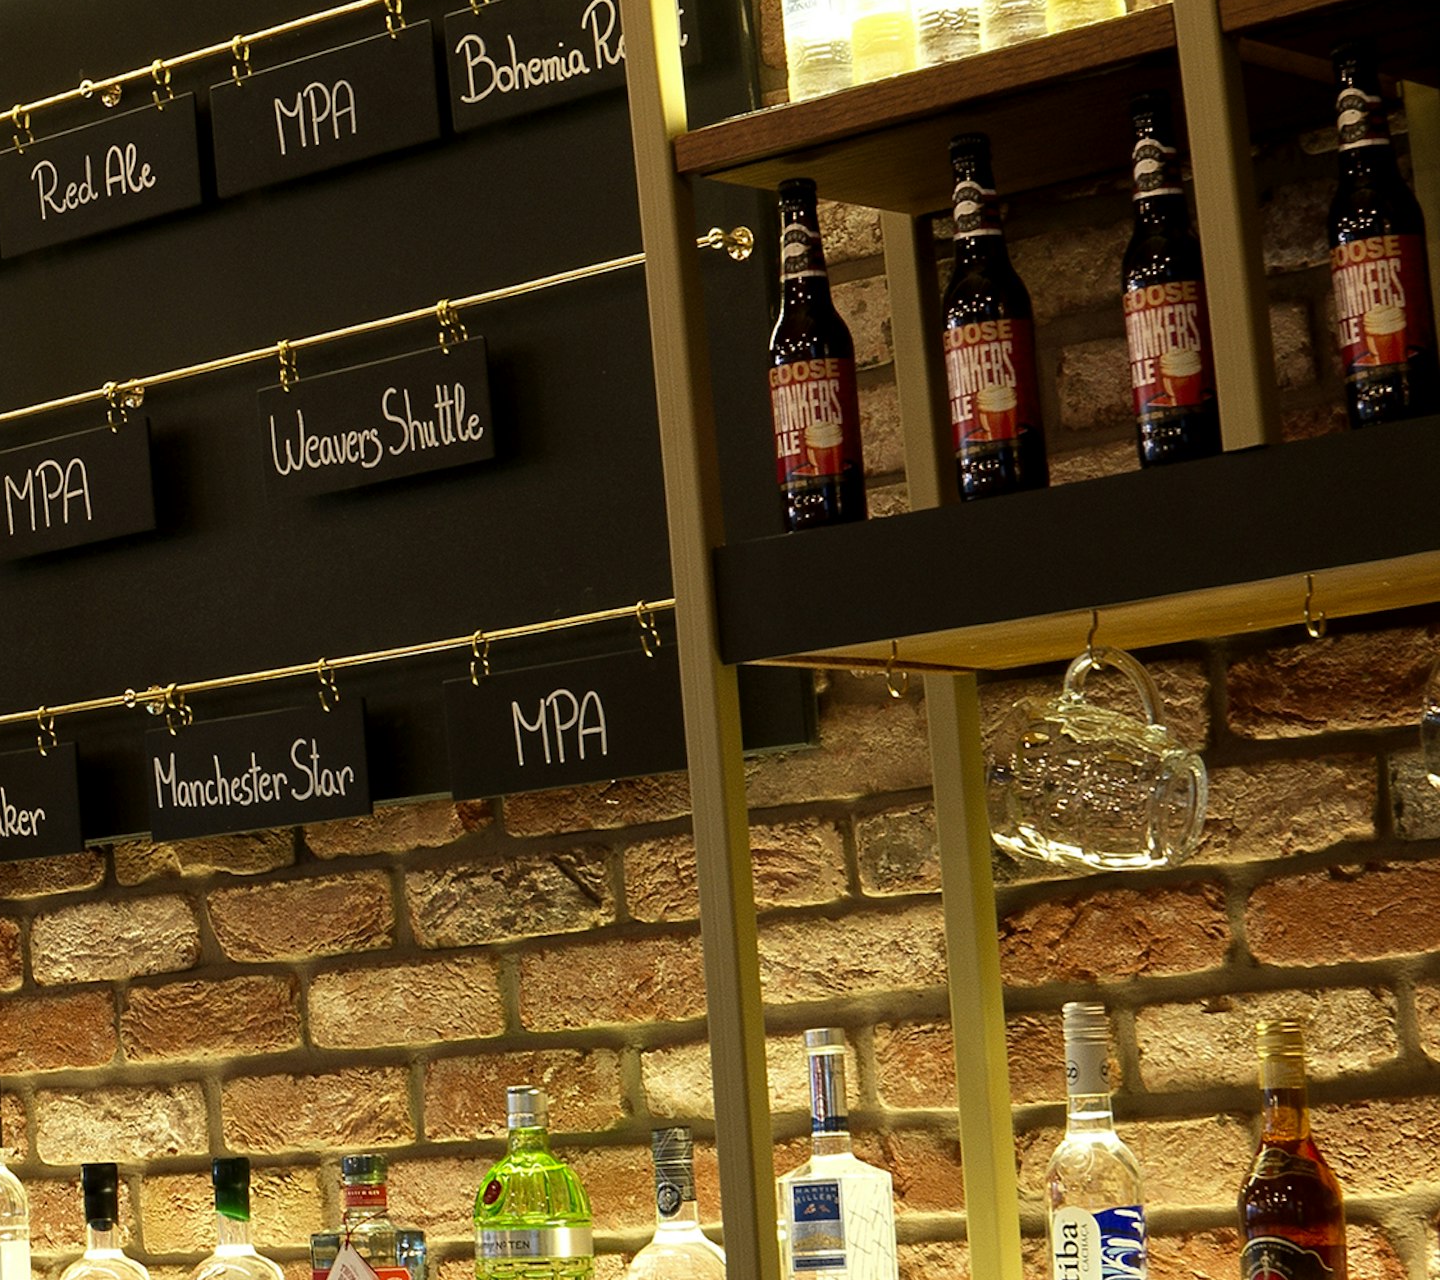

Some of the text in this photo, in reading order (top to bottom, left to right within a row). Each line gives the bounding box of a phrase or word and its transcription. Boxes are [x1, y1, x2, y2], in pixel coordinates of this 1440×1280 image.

[455, 34, 590, 103] Bohemia
[274, 80, 357, 156] MPA
[31, 142, 156, 221] Red Ale
[1123, 281, 1198, 314] GOOSE
[943, 321, 1013, 350] GOOSE
[769, 358, 840, 387] GOOSE
[270, 382, 484, 476] Weavers Shuttle
[777, 432, 801, 459] ALE
[4, 457, 92, 535] MPA
[511, 689, 608, 767] MPA
[153, 738, 354, 810] Manchester Star
[795, 1186, 837, 1194] MARTIN
[508, 1240, 530, 1249] TEN
